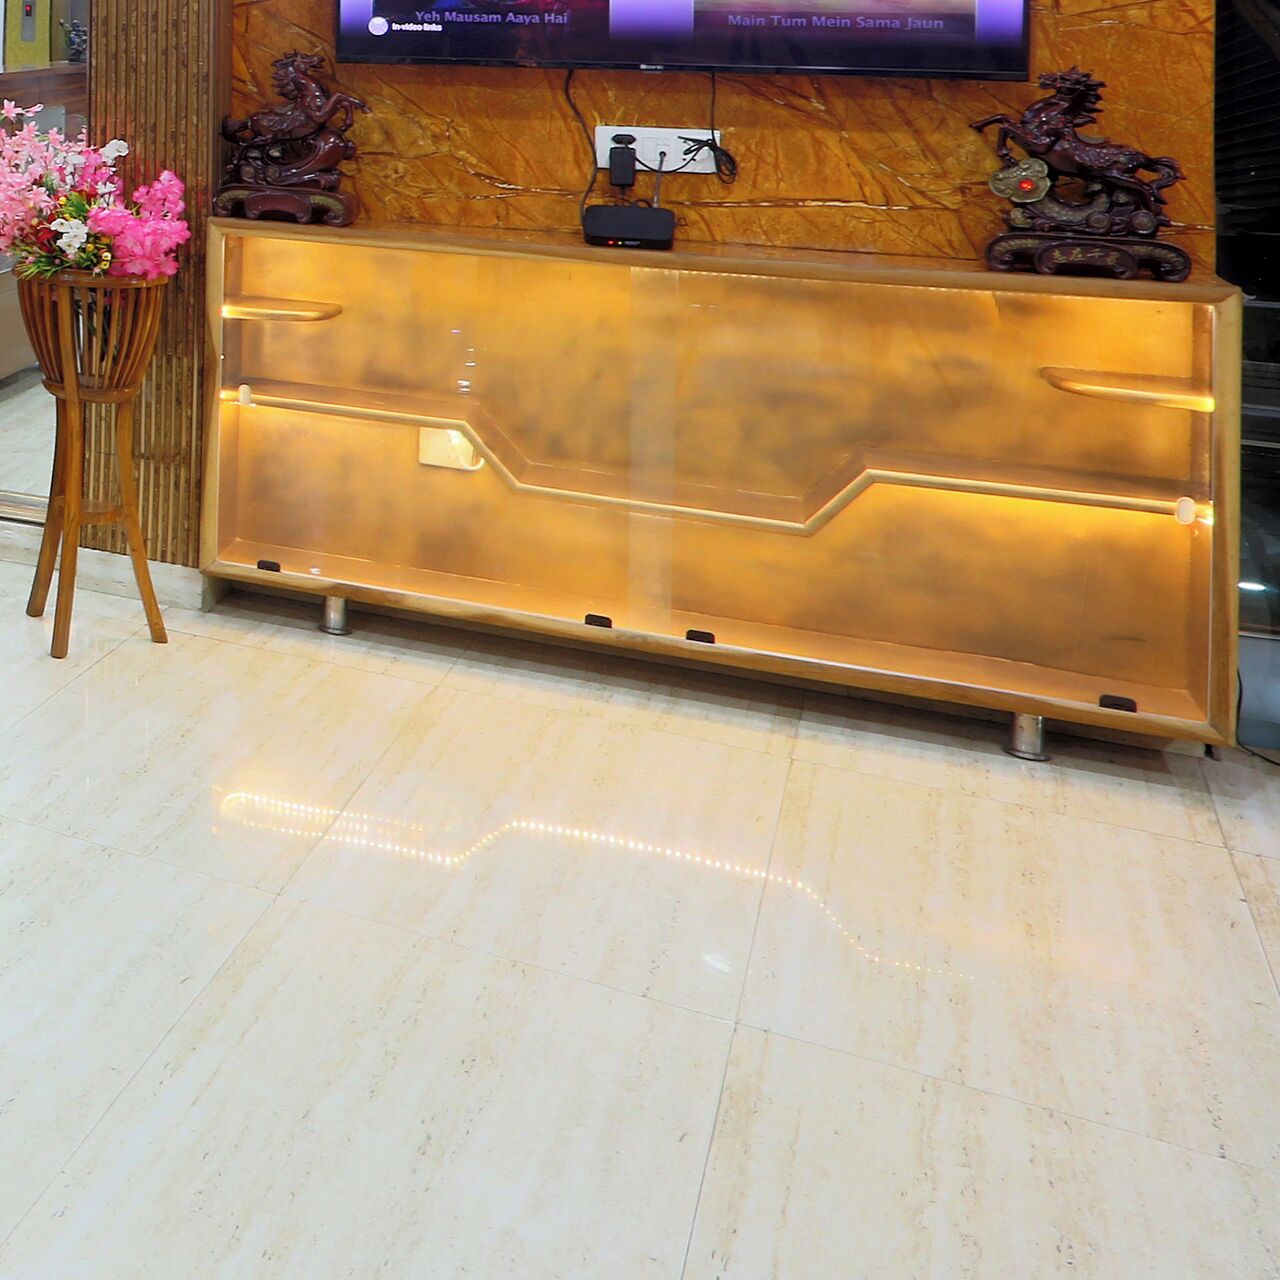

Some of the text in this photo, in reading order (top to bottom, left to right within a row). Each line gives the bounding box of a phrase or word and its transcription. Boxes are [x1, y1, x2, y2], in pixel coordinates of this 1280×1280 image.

[415, 10, 567, 25] Yeh Mausam Aaya Hai
[728, 14, 944, 30] Main Tum Mein Sama Jaun
